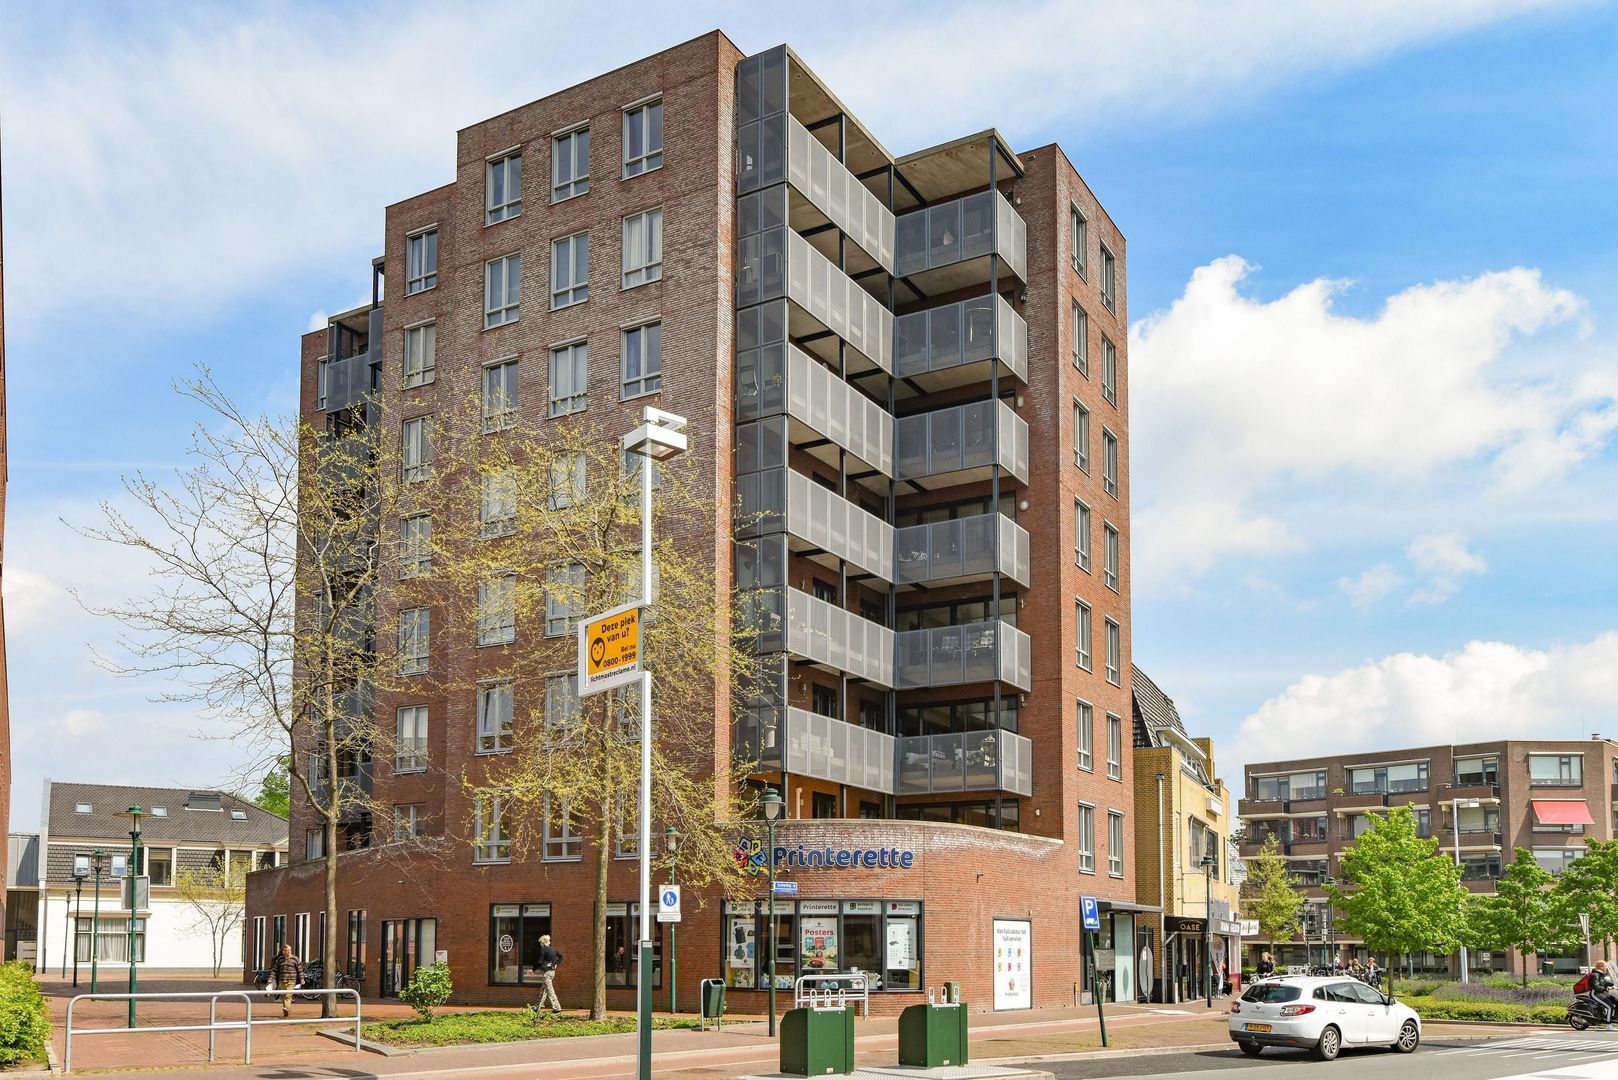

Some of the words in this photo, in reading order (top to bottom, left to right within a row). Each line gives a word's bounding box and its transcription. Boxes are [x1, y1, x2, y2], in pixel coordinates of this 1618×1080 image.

[601, 622, 619, 634] Deze
[620, 614, 636, 629] plek
[606, 633, 620, 642] van
[621, 628, 630, 638] u?
[773, 844, 914, 867] Printerette
[1085, 900, 1094, 915] P
[1180, 923, 1200, 931] OASE
